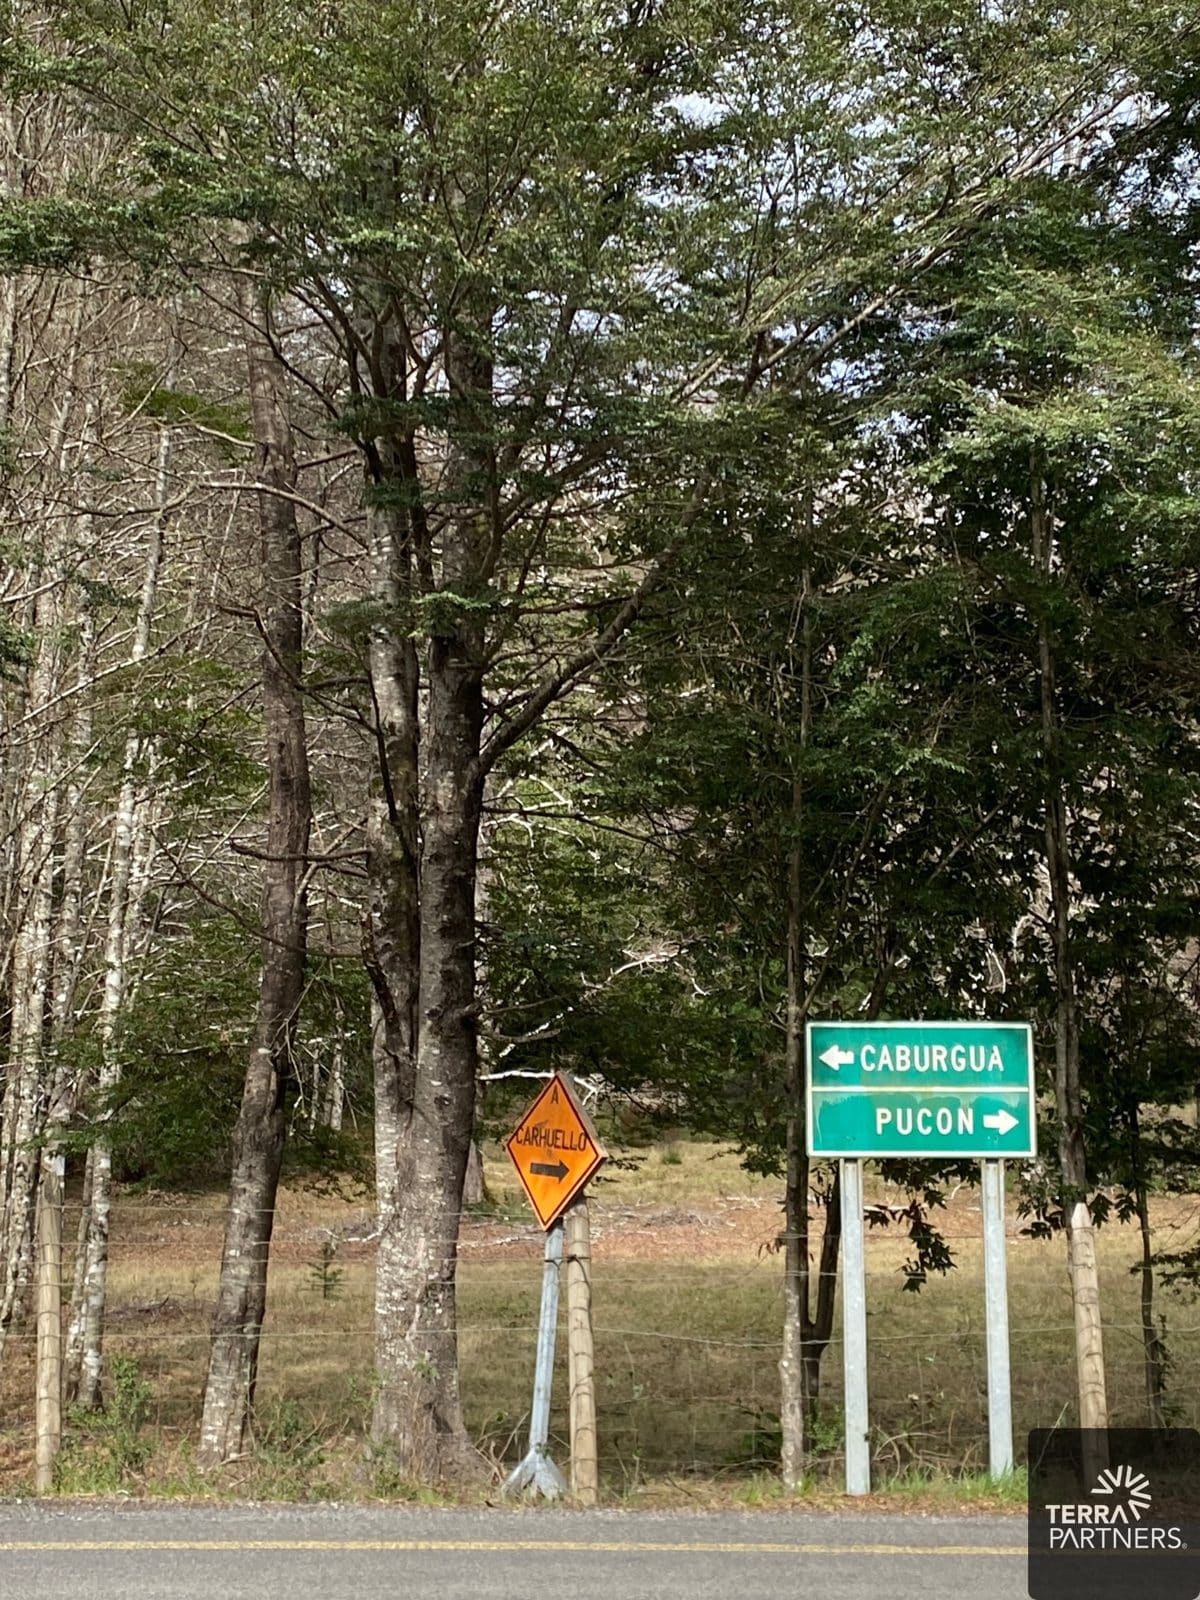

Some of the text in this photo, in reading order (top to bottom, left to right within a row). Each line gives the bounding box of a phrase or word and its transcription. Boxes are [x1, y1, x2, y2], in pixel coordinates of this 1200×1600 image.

[860, 1044, 1005, 1072] CABURGUA
[550, 1085, 559, 1105] A
[875, 1107, 974, 1135] PUCON
[515, 1126, 588, 1152] CARHUELLO
